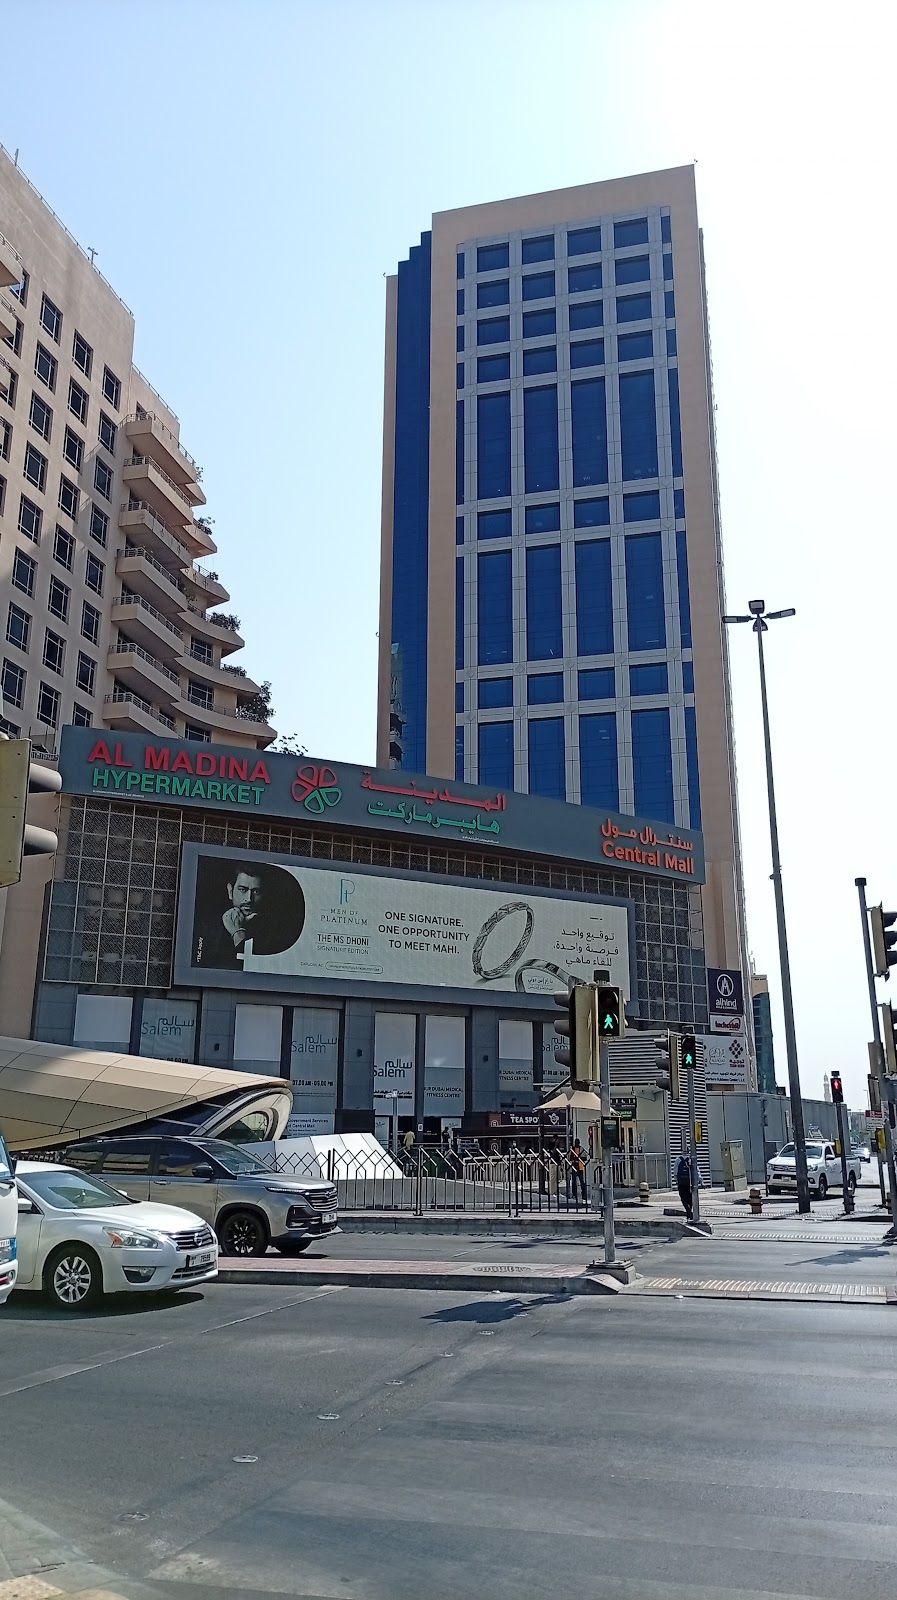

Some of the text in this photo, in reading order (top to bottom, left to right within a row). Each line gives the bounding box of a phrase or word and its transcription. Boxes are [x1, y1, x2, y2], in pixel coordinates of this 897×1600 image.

[88, 740, 271, 785] AL MADINA
[92, 768, 265, 805] HYPERMARKET
[361, 769, 507, 811] المدينة
[602, 818, 693, 851] سنترال مول
[602, 840, 695, 875] Central Mall
[320, 914, 368, 926] PLATINUM
[384, 911, 406, 921] ONE
[317, 933, 369, 946] THE MS DHONI
[378, 924, 470, 942] ONE OPPORTUNITY
[561, 927, 615, 942] توقيع واحد
[388, 939, 460, 955] TO MEET MAHI.
[585, 943, 618, 957] فرصة
[141, 1020, 182, 1036] Salem
[290, 1040, 327, 1054] Salem
[373, 1064, 406, 1078] Salem
[384, 1058, 413, 1069] سالم
[510, 1116, 540, 1124] TEA SPO
